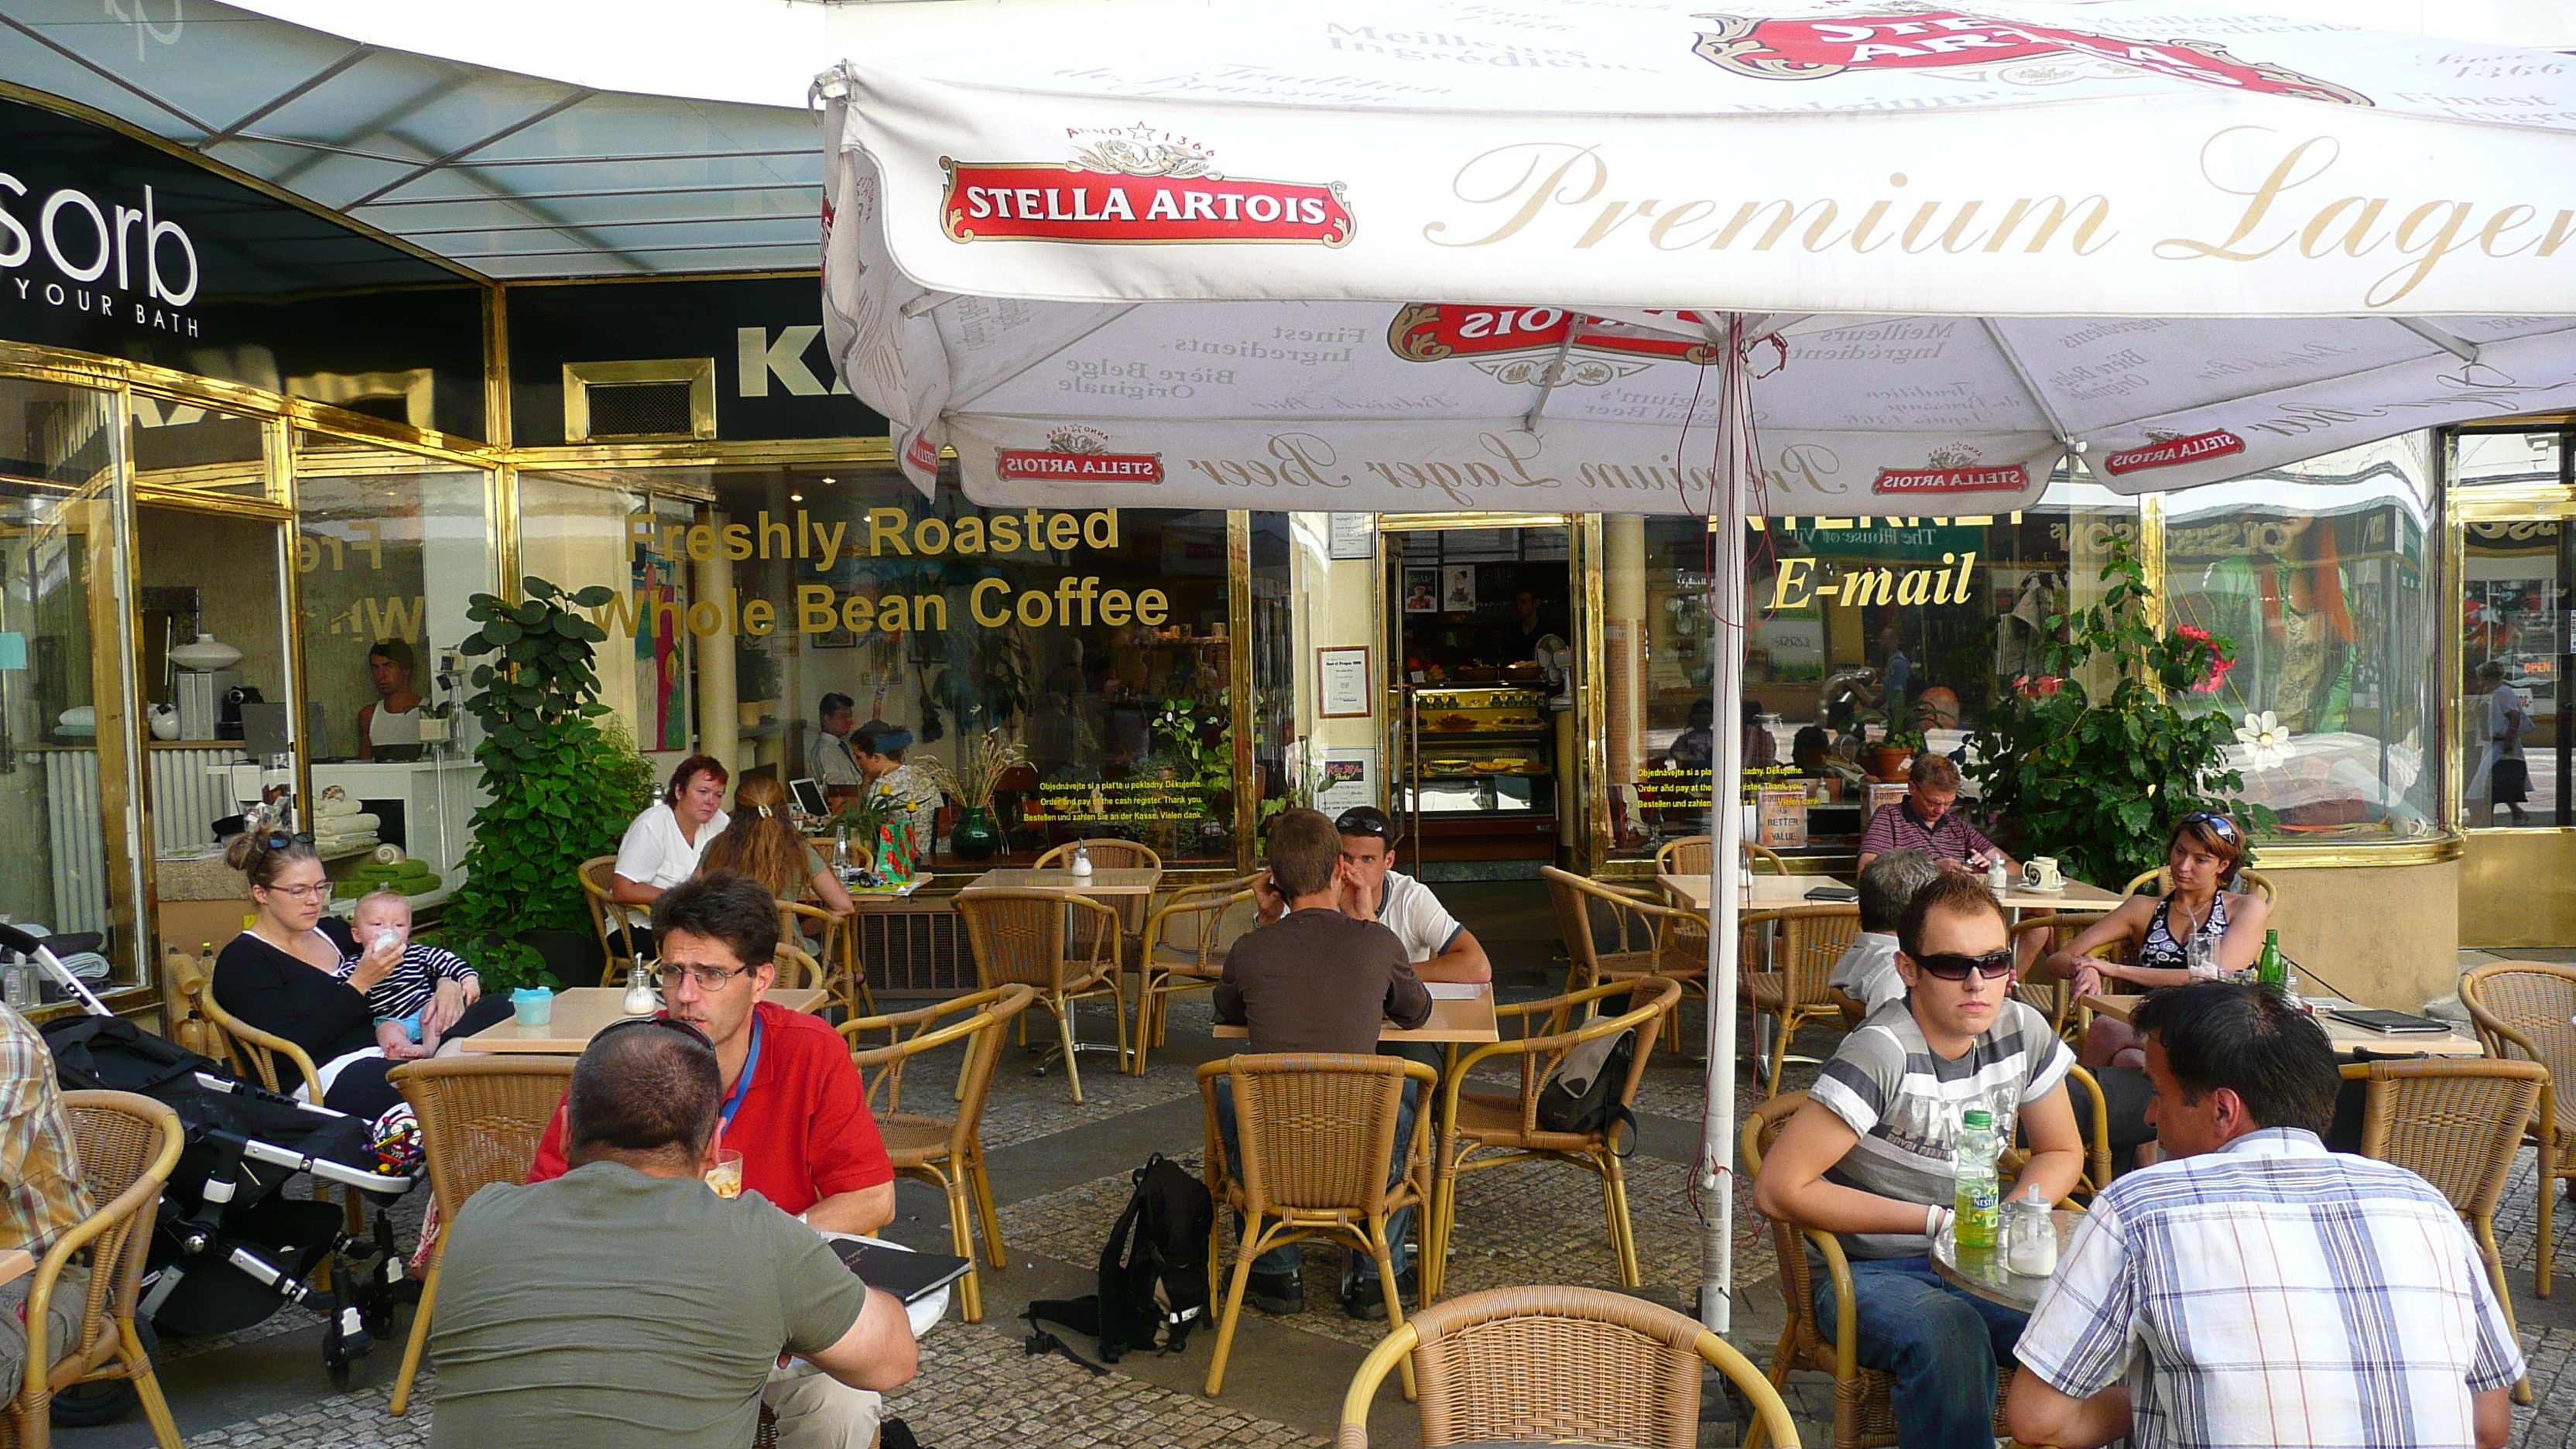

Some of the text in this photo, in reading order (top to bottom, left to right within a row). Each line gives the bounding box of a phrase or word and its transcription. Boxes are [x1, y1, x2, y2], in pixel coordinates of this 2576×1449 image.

[1324, 22, 1588, 59] Meilleurs
[1326, 36, 1661, 74] Ingrédients
[2386, 91, 2557, 106] Finest
[1065, 125, 1216, 157] ANNO 1366
[968, 187, 1327, 225] STELLA ARTOIS
[1422, 125, 2576, 309] Premium Lager
[0, 172, 198, 307] sorb
[15, 277, 199, 338] YOUR BATH
[738, 325, 851, 397] K
[624, 507, 1120, 572] Freshly Roasted
[1764, 551, 1977, 609] E-mail
[590, 576, 1170, 639] Whole Bean Coffee
[2524, 662, 2552, 673] OPEN
[1040, 797, 1061, 807] Order
[1077, 799, 1091, 808] pay
[1101, 797, 1113, 806] the
[1115, 797, 1132, 806] cash
[1133, 797, 1163, 807] register.
[1164, 796, 1186, 806] Thank
[1637, 800, 1672, 809] Bestellen
[1672, 800, 1686, 808] und
[1687, 800, 1712, 809] zahlen
[1638, 784, 1659, 793] Order
[1660, 784, 1674, 793] and
[1675, 785, 1690, 795] pay
[1690, 783, 1700, 793] at
[1700, 783, 1713, 792] the
[1763, 782, 1786, 791] Thank
[1023, 814, 1057, 822] Bestellen
[1057, 814, 1071, 822] und
[1072, 813, 1096, 821] zahlen
[1097, 812, 1109, 821] Sie
[1120, 813, 1132, 821] der
[1133, 812, 1159, 821] Kasse.
[1160, 811, 1183, 820] Vielen
[1184, 811, 1203, 820] dank.
[1767, 817, 1799, 827] BETTER
[1771, 832, 1797, 841] VALUE
